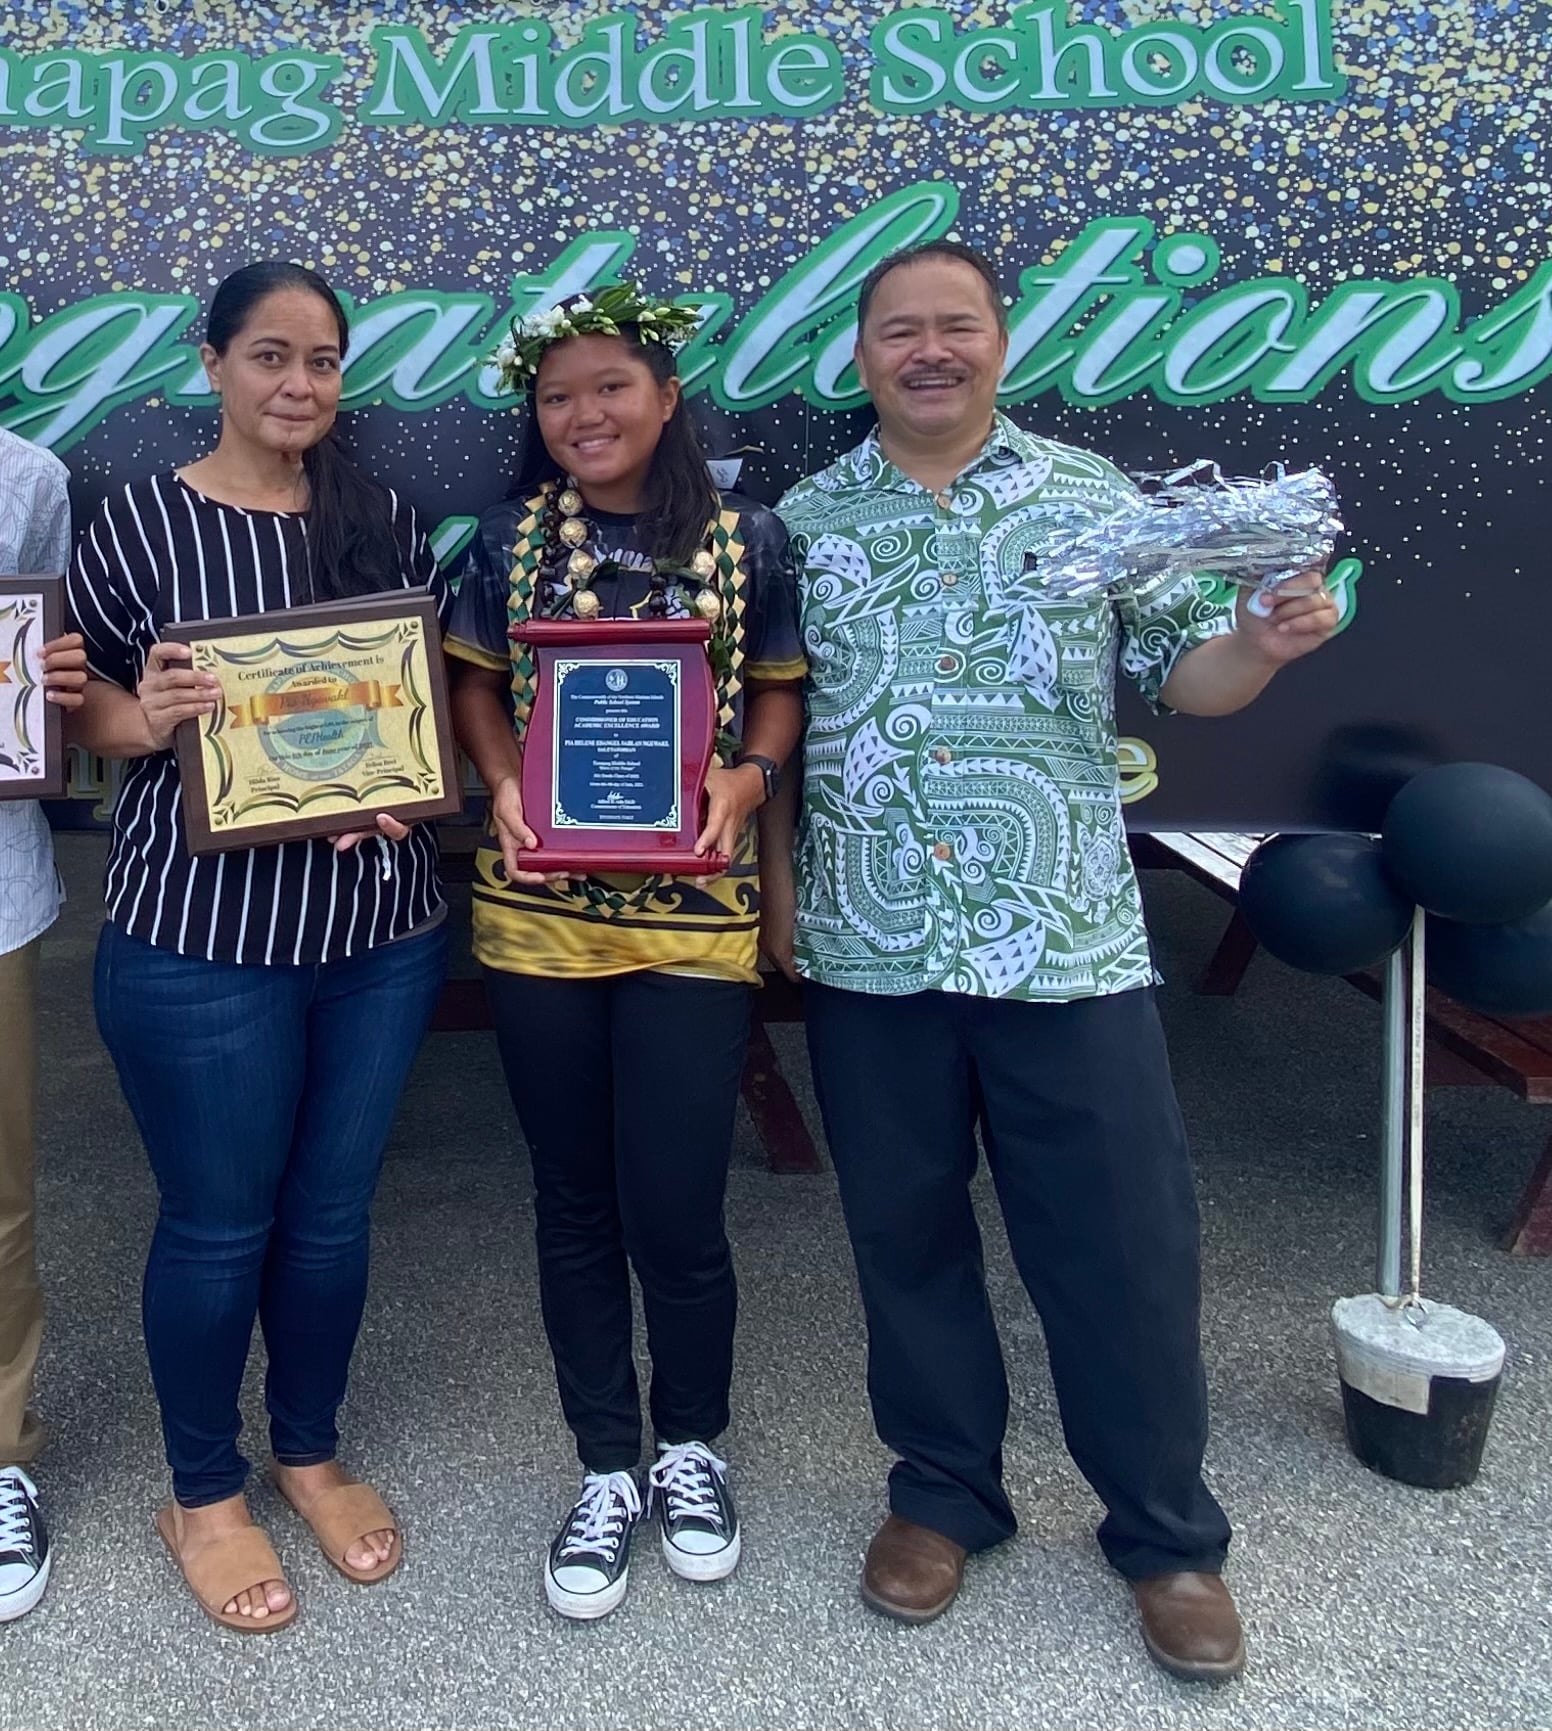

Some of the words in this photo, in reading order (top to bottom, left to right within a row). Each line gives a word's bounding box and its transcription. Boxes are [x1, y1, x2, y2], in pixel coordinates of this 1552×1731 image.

[368, 15, 834, 119] Middle
[880, 0, 1335, 105] School
[238, 665, 295, 681] Certificate
